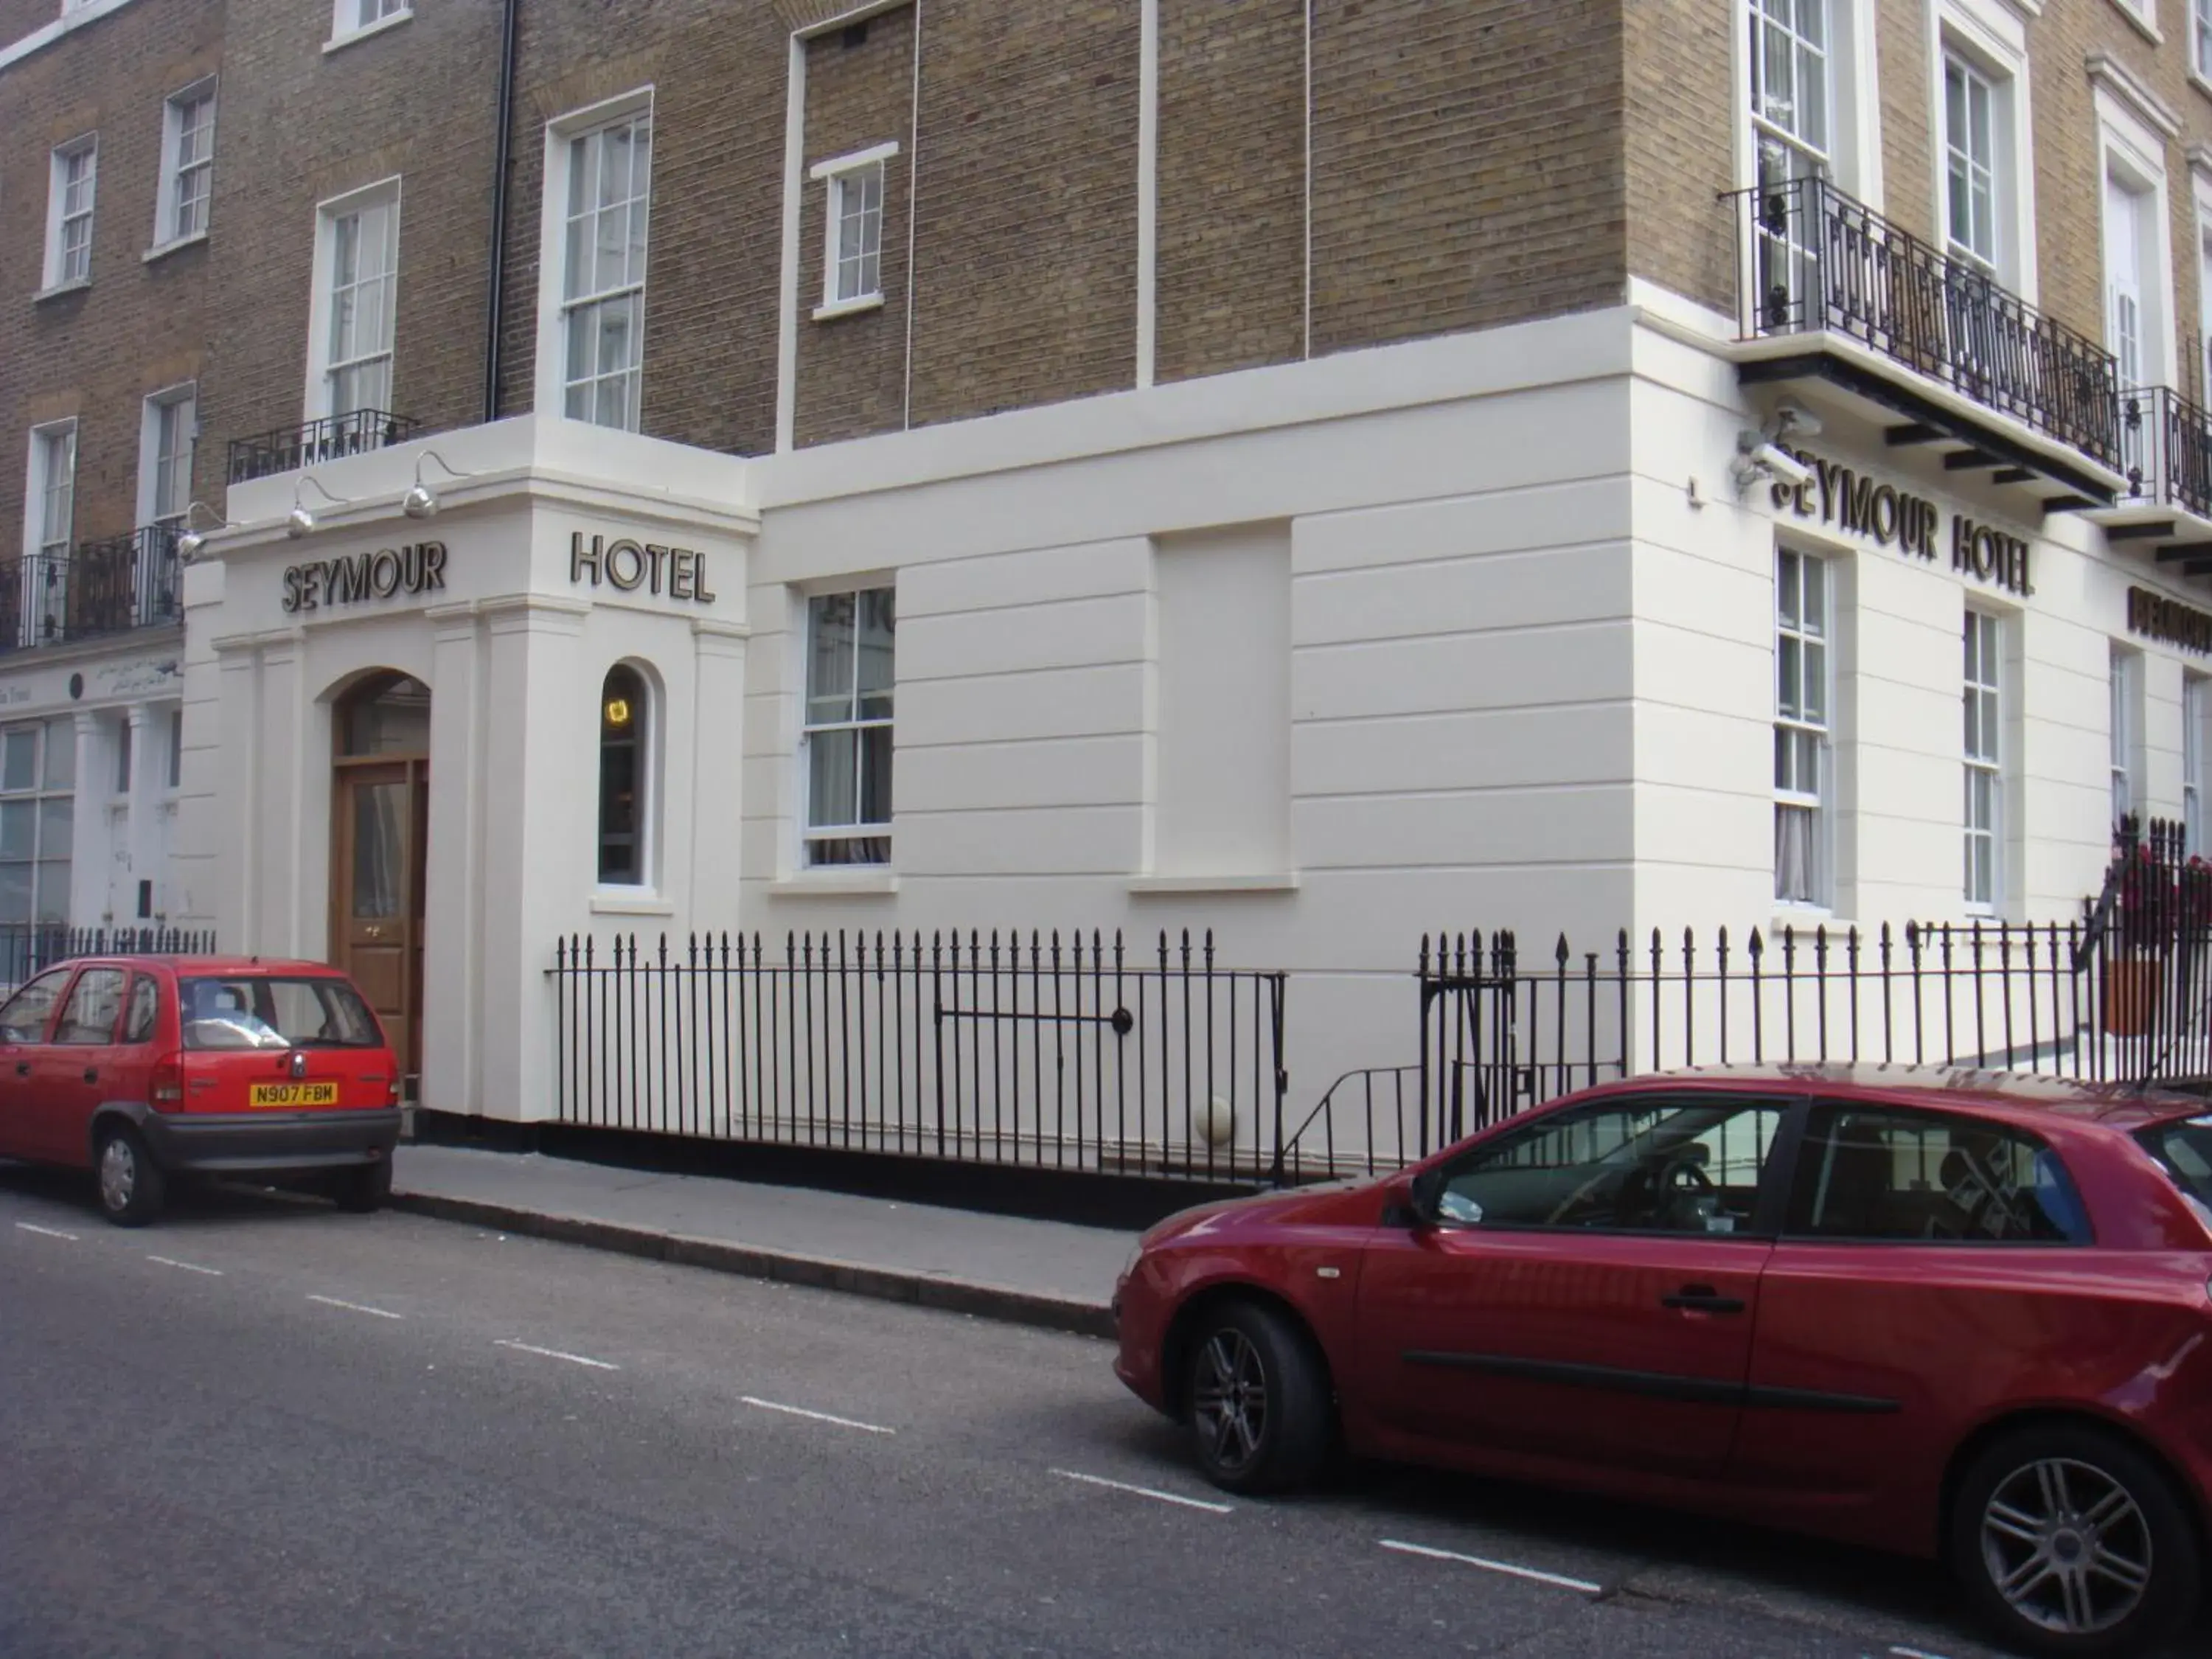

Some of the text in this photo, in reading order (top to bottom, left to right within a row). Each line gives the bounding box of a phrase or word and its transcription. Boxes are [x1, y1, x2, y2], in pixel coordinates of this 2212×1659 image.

[282, 530, 716, 613] SEYMOUR HOTEL
[1951, 514, 2036, 596] HOTEL
[256, 1085, 298, 1102] N907
